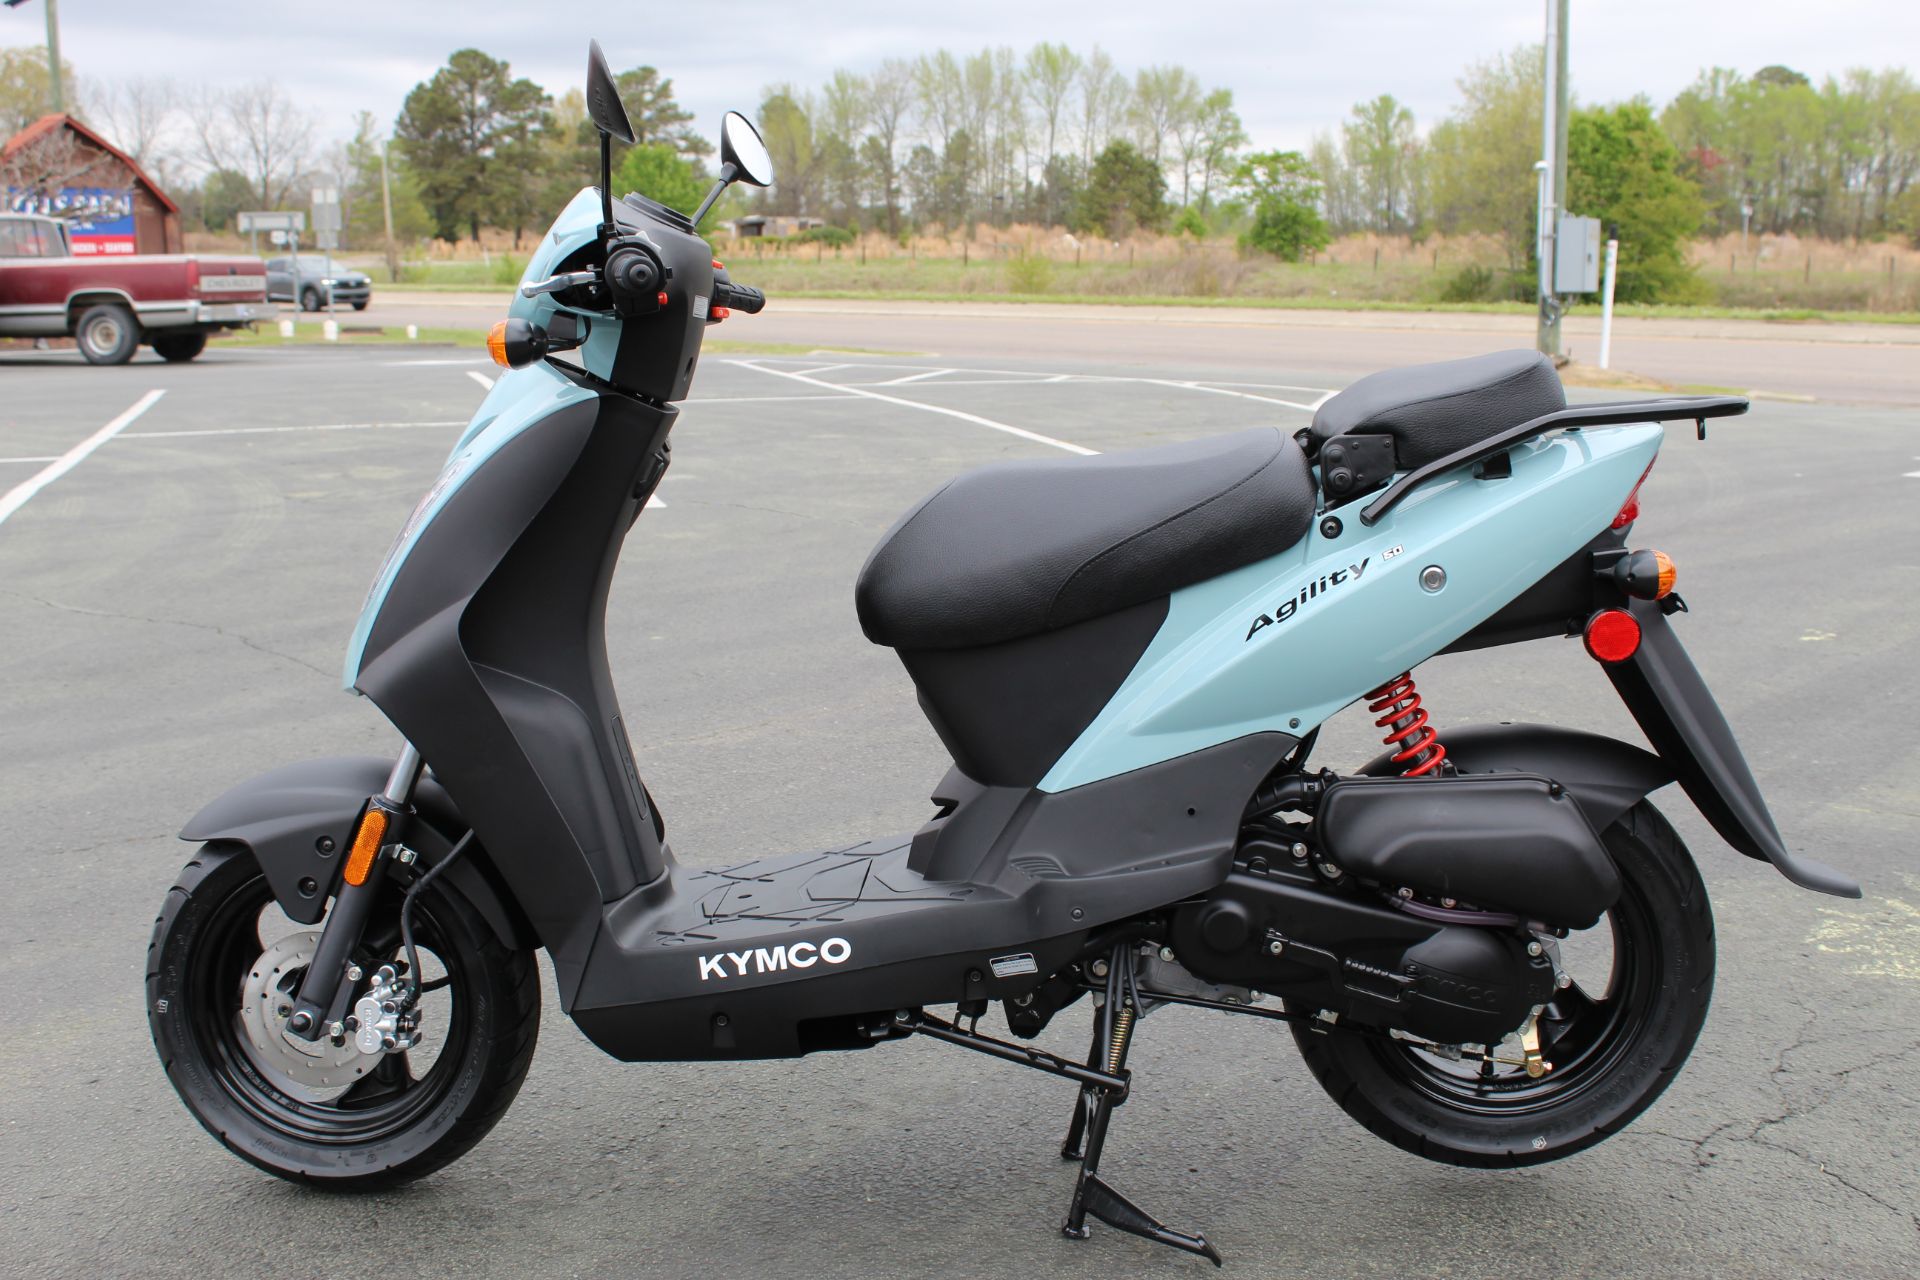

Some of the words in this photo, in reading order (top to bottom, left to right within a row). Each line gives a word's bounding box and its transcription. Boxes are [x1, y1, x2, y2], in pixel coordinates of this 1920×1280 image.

[206, 278, 261, 288] CHEVROLET
[1245, 557, 1370, 642] Agility
[698, 937, 852, 980] KYMCO
